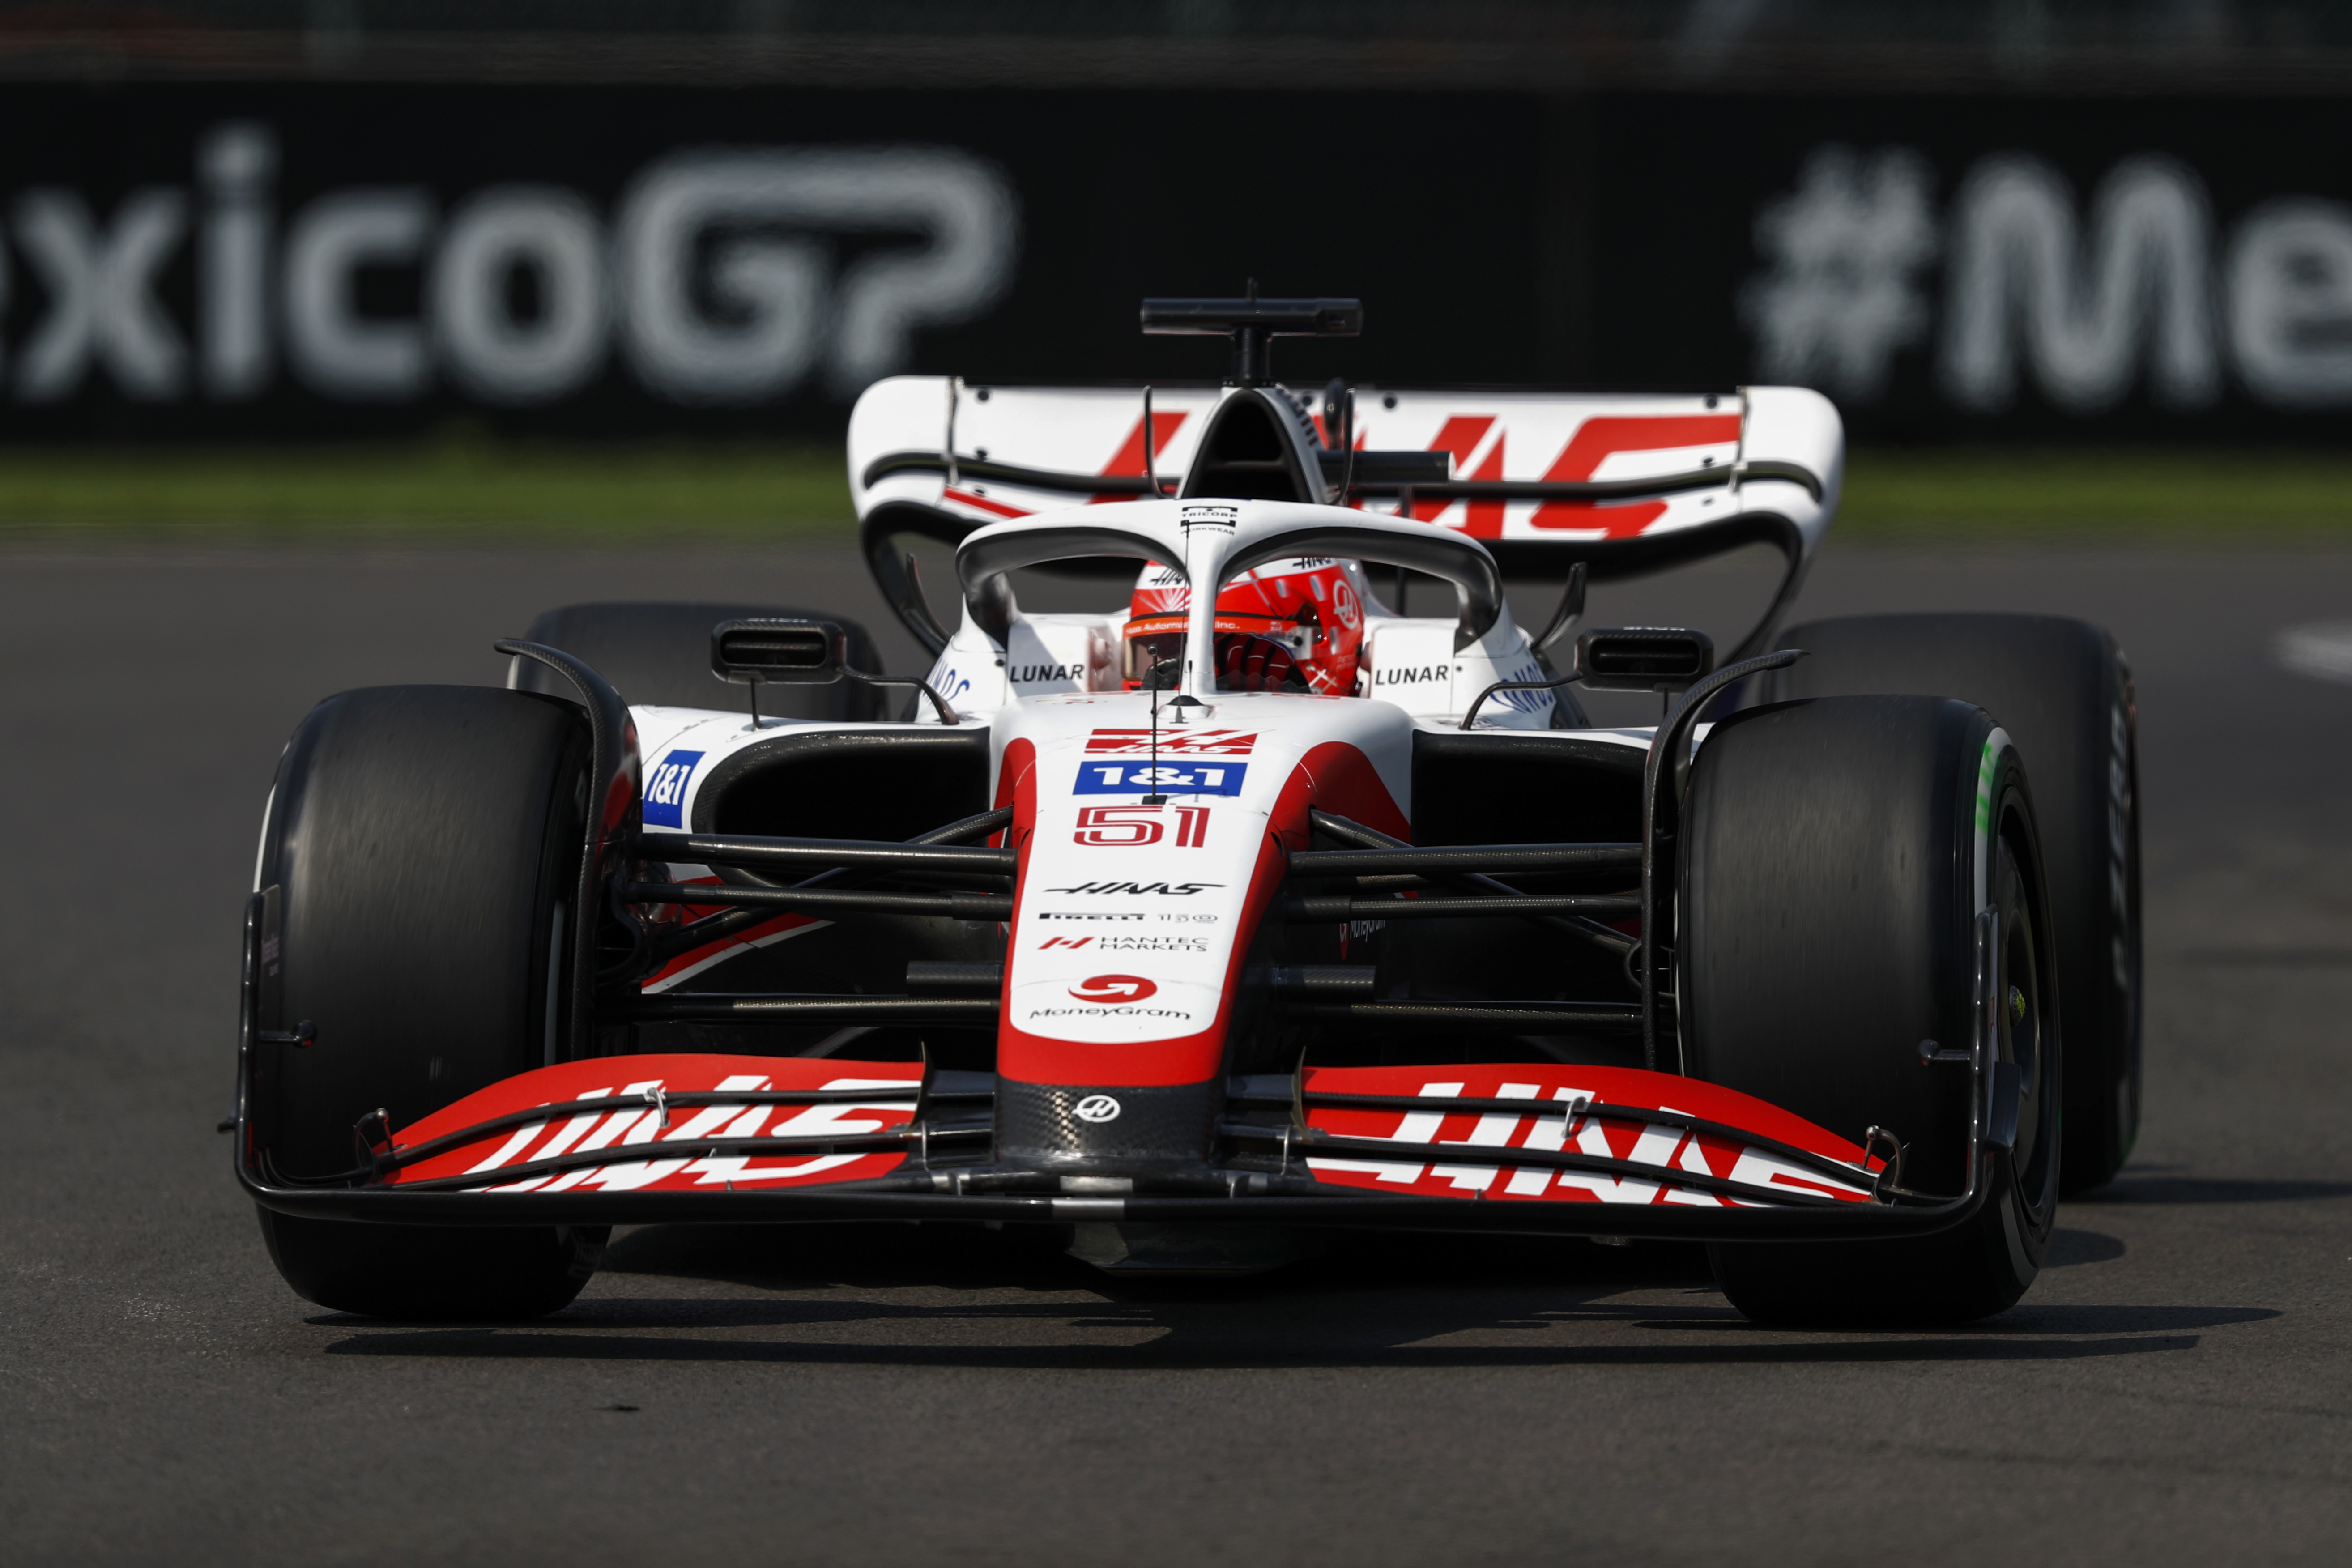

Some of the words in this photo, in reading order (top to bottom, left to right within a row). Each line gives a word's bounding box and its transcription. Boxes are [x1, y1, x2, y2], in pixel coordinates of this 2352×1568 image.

[0, 123, 1016, 396] xicoGP
[1010, 664, 1085, 682] LUNAR
[1376, 665, 1448, 686] LUNAR
[648, 763, 691, 805] 1&1
[1093, 767, 1225, 786] 1&1
[1074, 805, 1210, 848] 51
[1042, 882, 1228, 895] HAAS
[1100, 943, 1207, 951] MARKETS
[1029, 1007, 1191, 1019] MoneyGram
